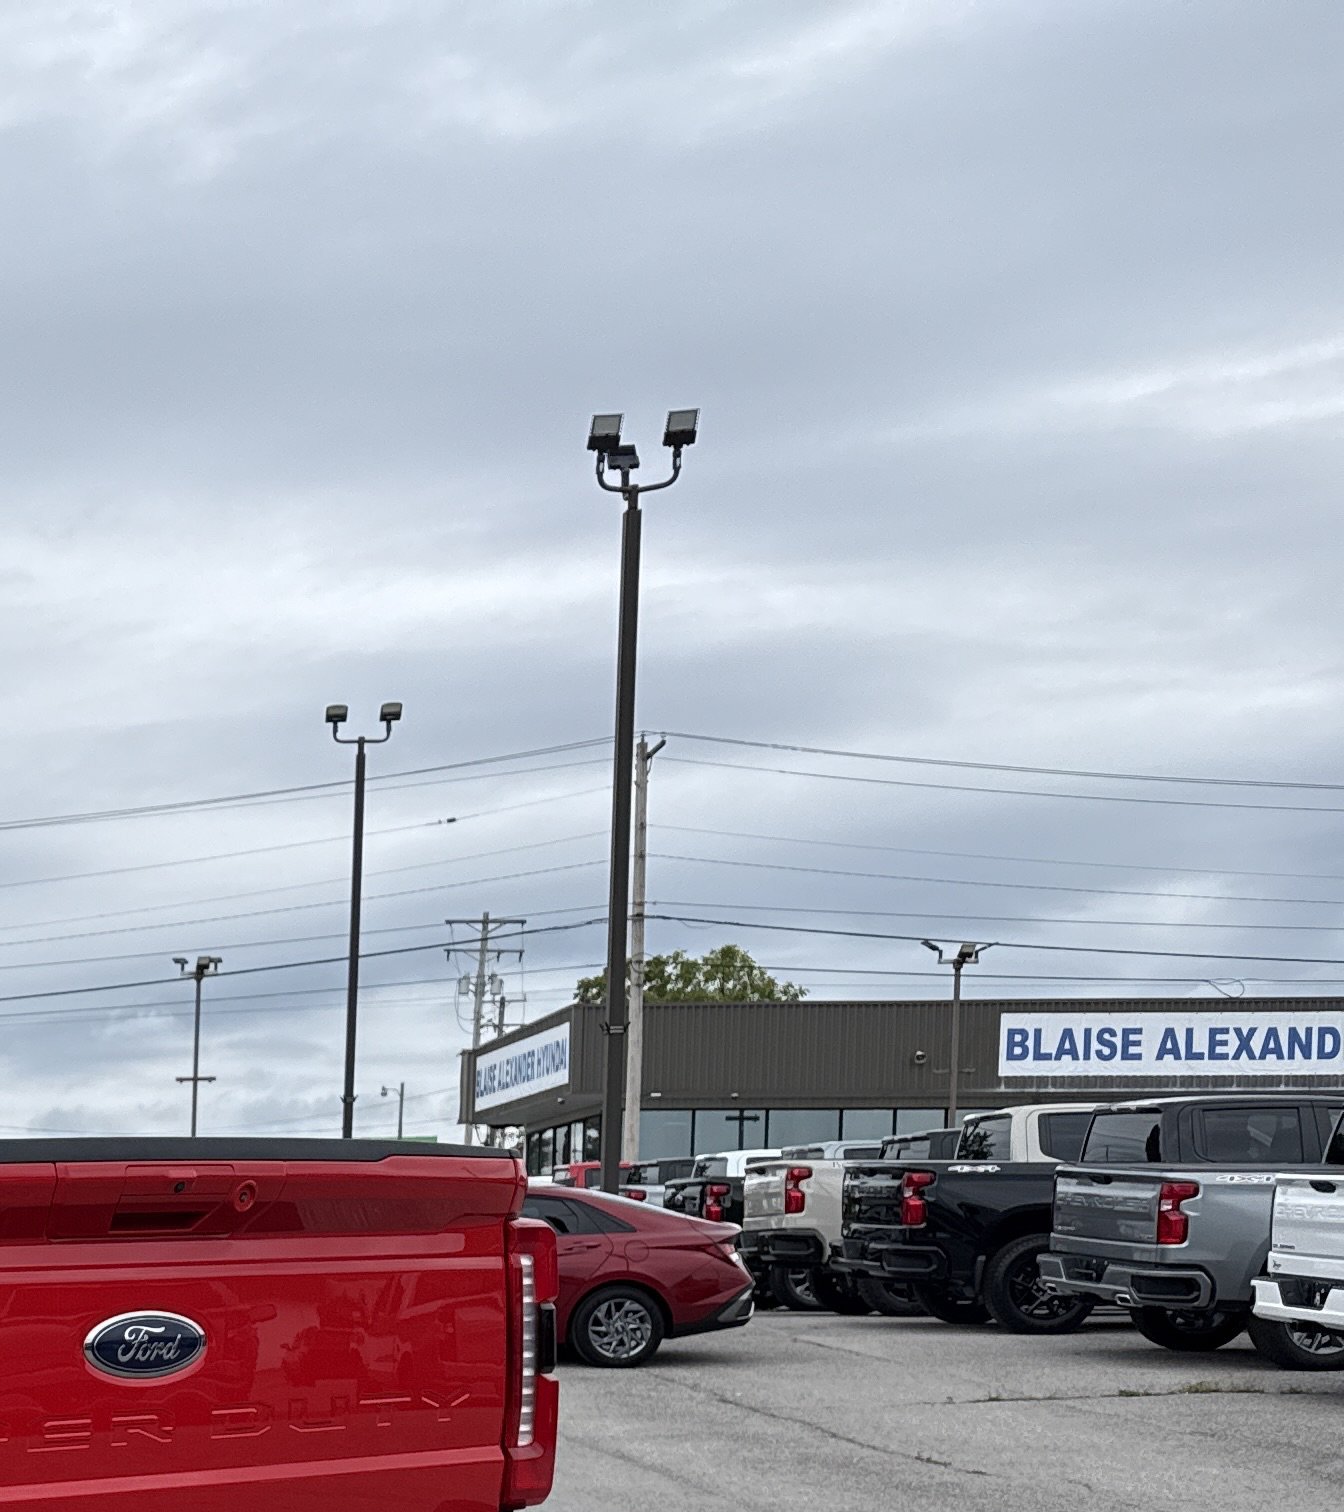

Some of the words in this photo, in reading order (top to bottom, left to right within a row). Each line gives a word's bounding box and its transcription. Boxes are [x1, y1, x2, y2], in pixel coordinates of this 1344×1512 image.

[1005, 1026, 1144, 1062] BLAISE
[1155, 1026, 1342, 1061] ALEXAND
[475, 1063, 497, 1099] BLAISE
[117, 1325, 182, 1363] Ford
[210, 1391, 471, 1440] DUTY
